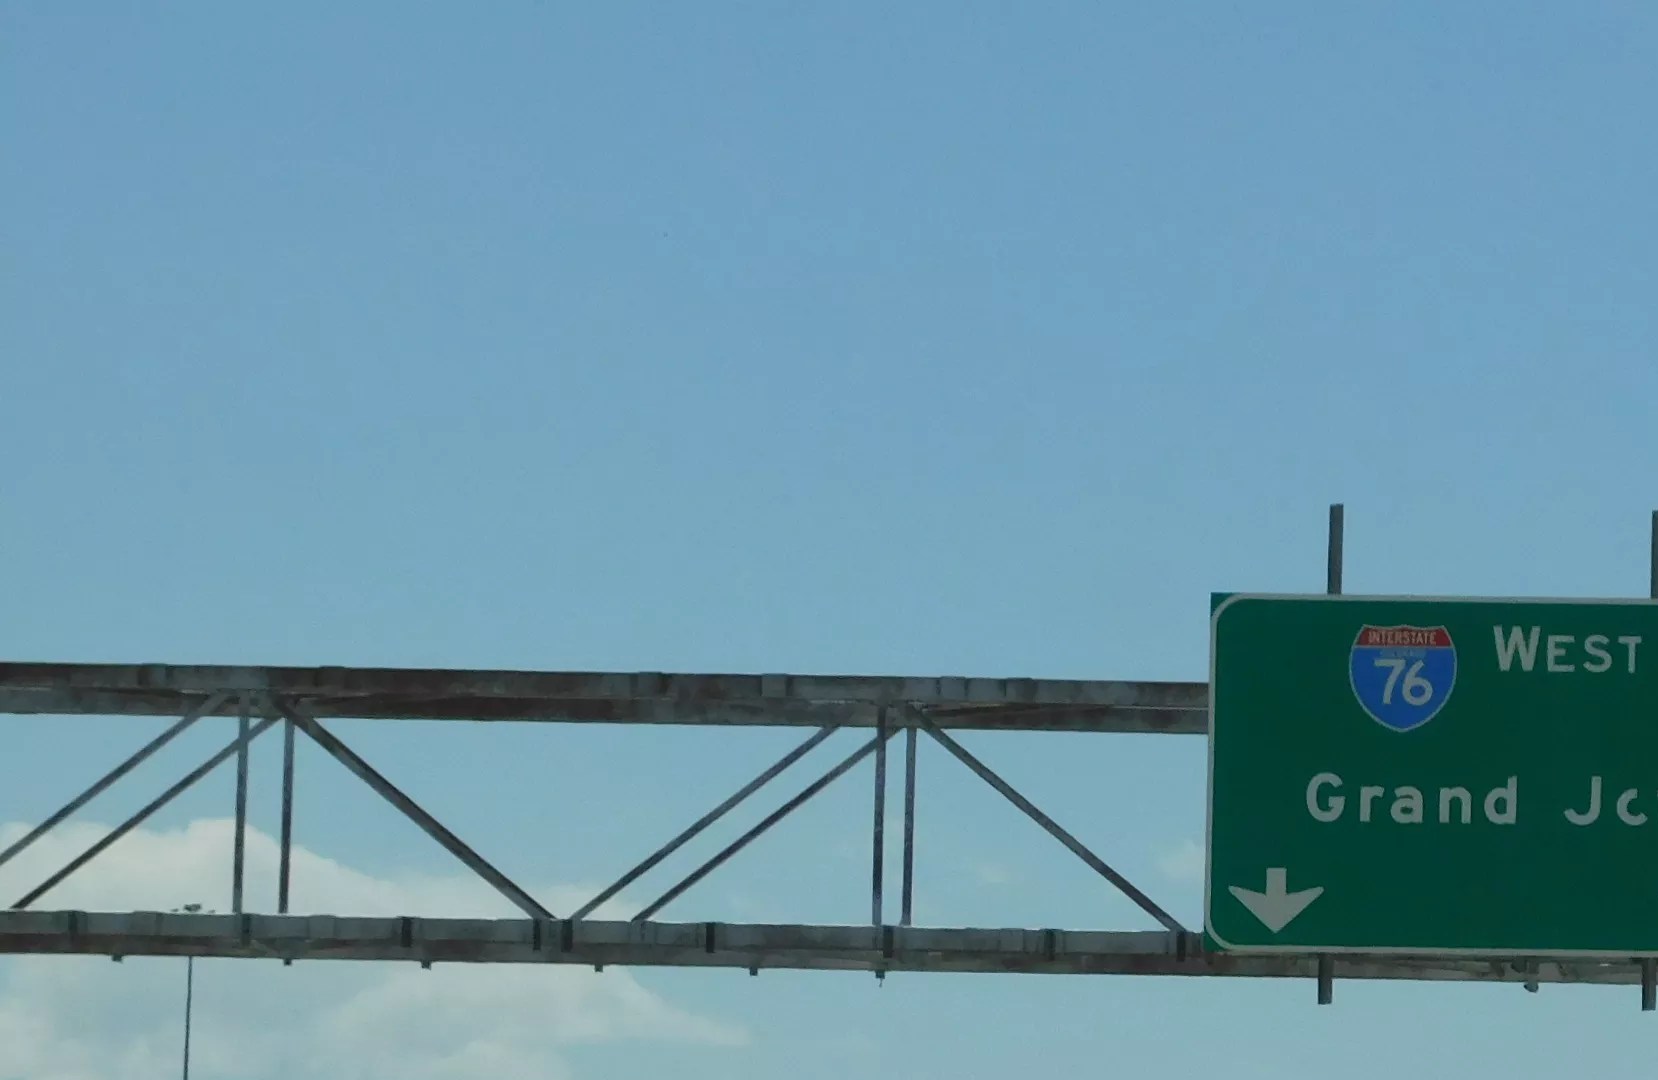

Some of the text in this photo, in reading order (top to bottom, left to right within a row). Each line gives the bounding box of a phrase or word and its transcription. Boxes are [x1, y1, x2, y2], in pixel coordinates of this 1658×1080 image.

[1368, 630, 1437, 645] INTERSTATE
[1493, 625, 1642, 674] WEST
[1373, 658, 1434, 706] 76
[1306, 772, 1518, 825] Grand
